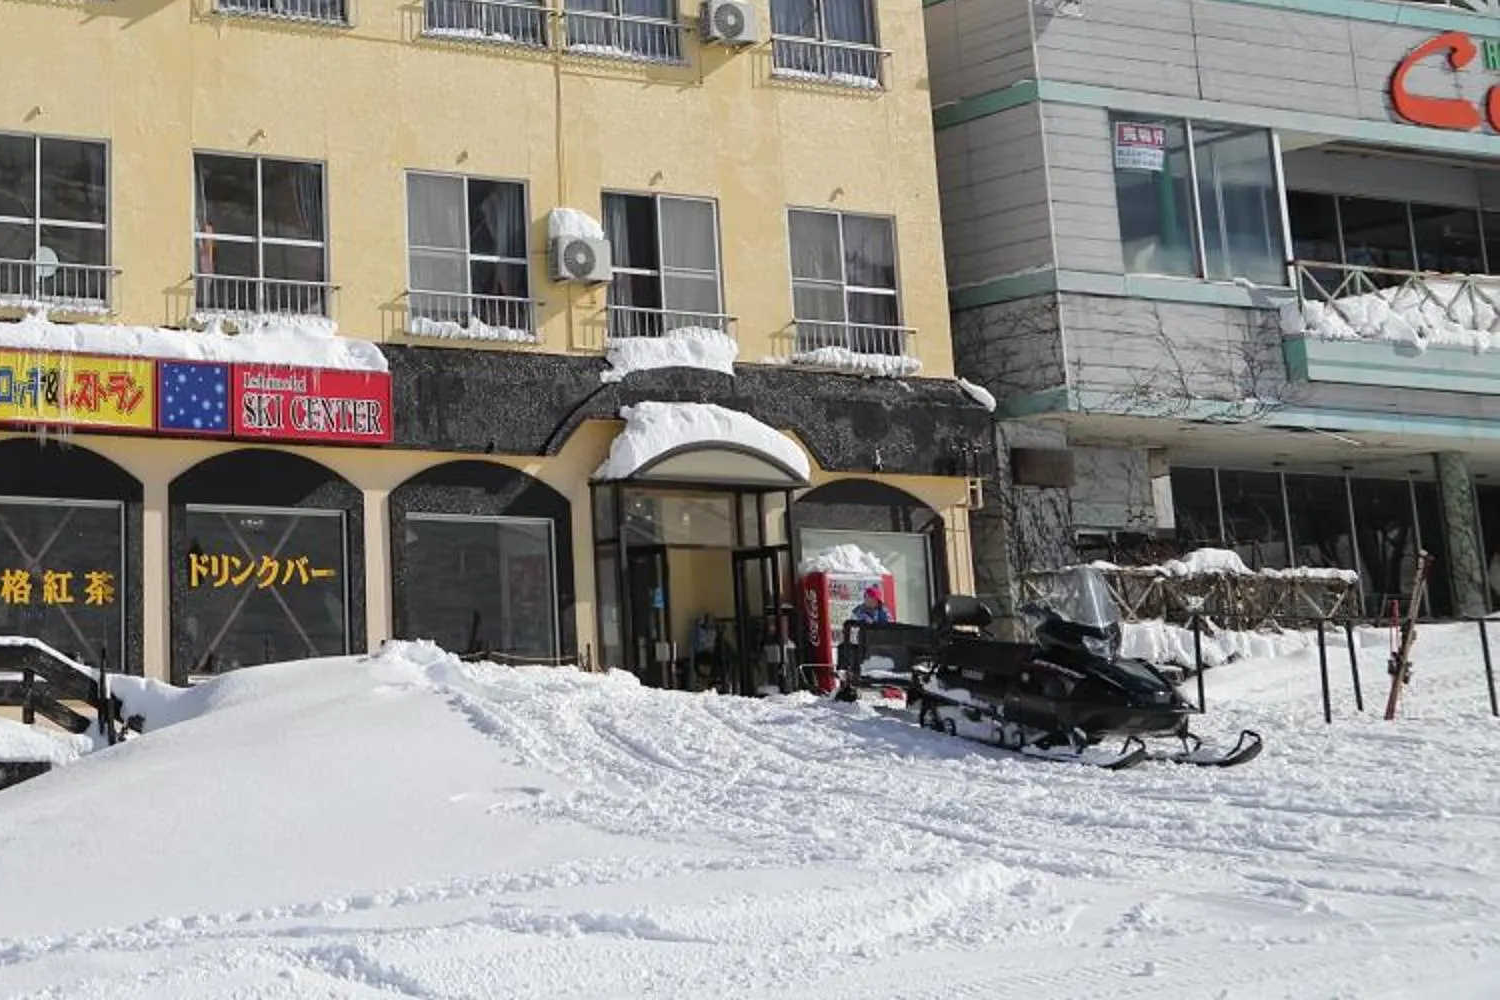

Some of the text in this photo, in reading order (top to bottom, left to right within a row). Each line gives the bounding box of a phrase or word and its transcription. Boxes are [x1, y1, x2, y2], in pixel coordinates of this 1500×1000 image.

[242, 393, 384, 435] SKI CENTER
[189, 552, 337, 590] ドリンクバー
